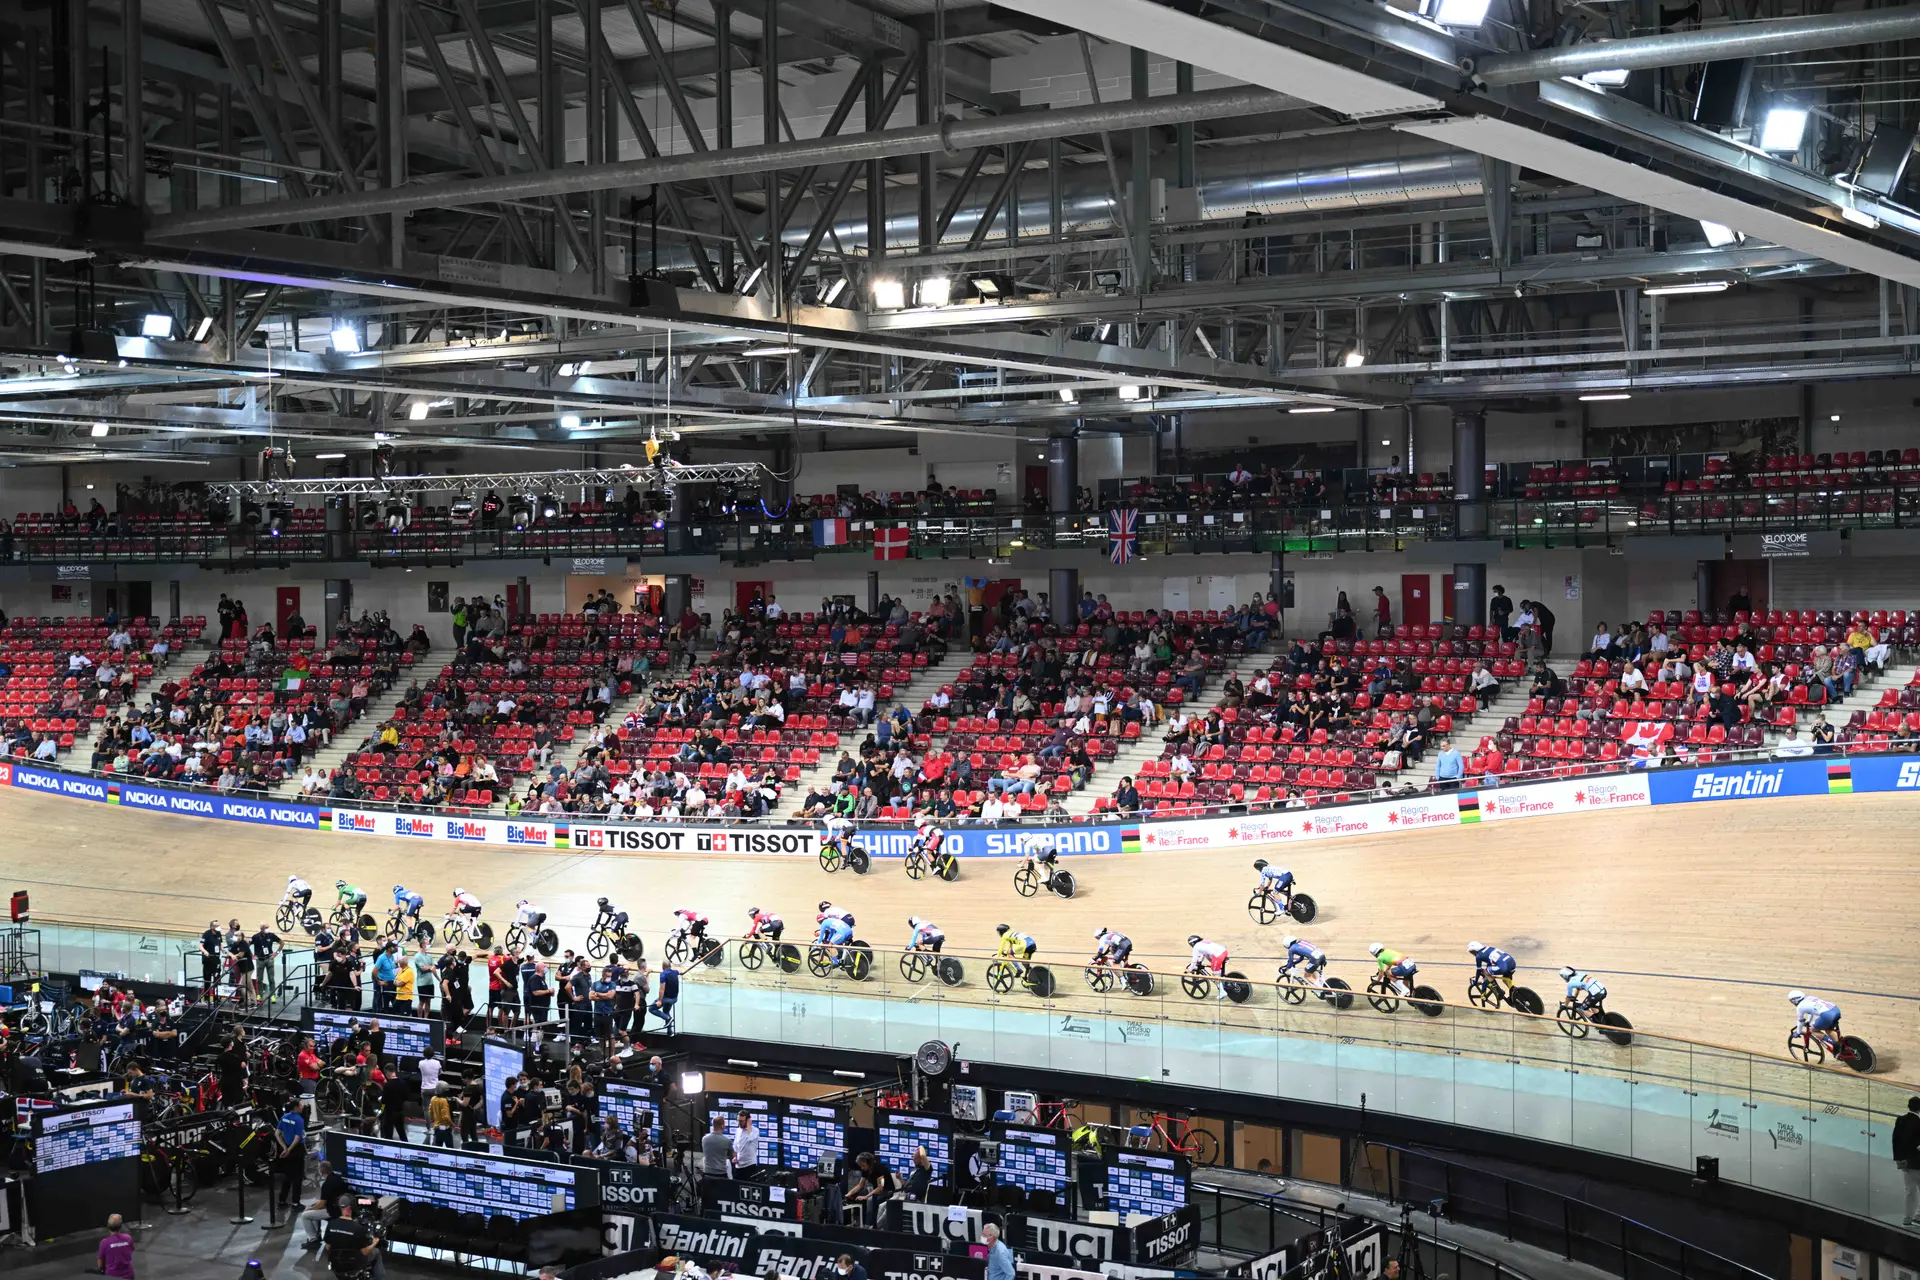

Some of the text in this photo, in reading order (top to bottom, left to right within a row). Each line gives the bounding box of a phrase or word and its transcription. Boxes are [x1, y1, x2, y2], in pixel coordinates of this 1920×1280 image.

[1760, 533, 1808, 544] VELODROME
[18, 772, 104, 798] NOKIA NOKIA
[1692, 768, 1784, 798] Santini
[1896, 762, 1920, 788] S
[125, 791, 315, 824] NOKIA NOKIA NOKIA NOKIA
[339, 813, 375, 830] BigMat
[396, 818, 433, 835] BigMat
[447, 822, 486, 839] BigMat
[507, 826, 547, 843] BigMat
[606, 830, 684, 850] TISSOT
[730, 834, 813, 853] TISSOT
[1341, 1037, 1356, 1045] 190
[82, 1109, 105, 1117] TISSOT
[602, 1185, 658, 1204] ISSOT
[601, 1222, 628, 1250] CI
[917, 1212, 976, 1241] UCI
[659, 1223, 750, 1258] Santini
[1041, 1228, 1106, 1260] UCI
[1146, 1222, 1191, 1258] TISSOT
